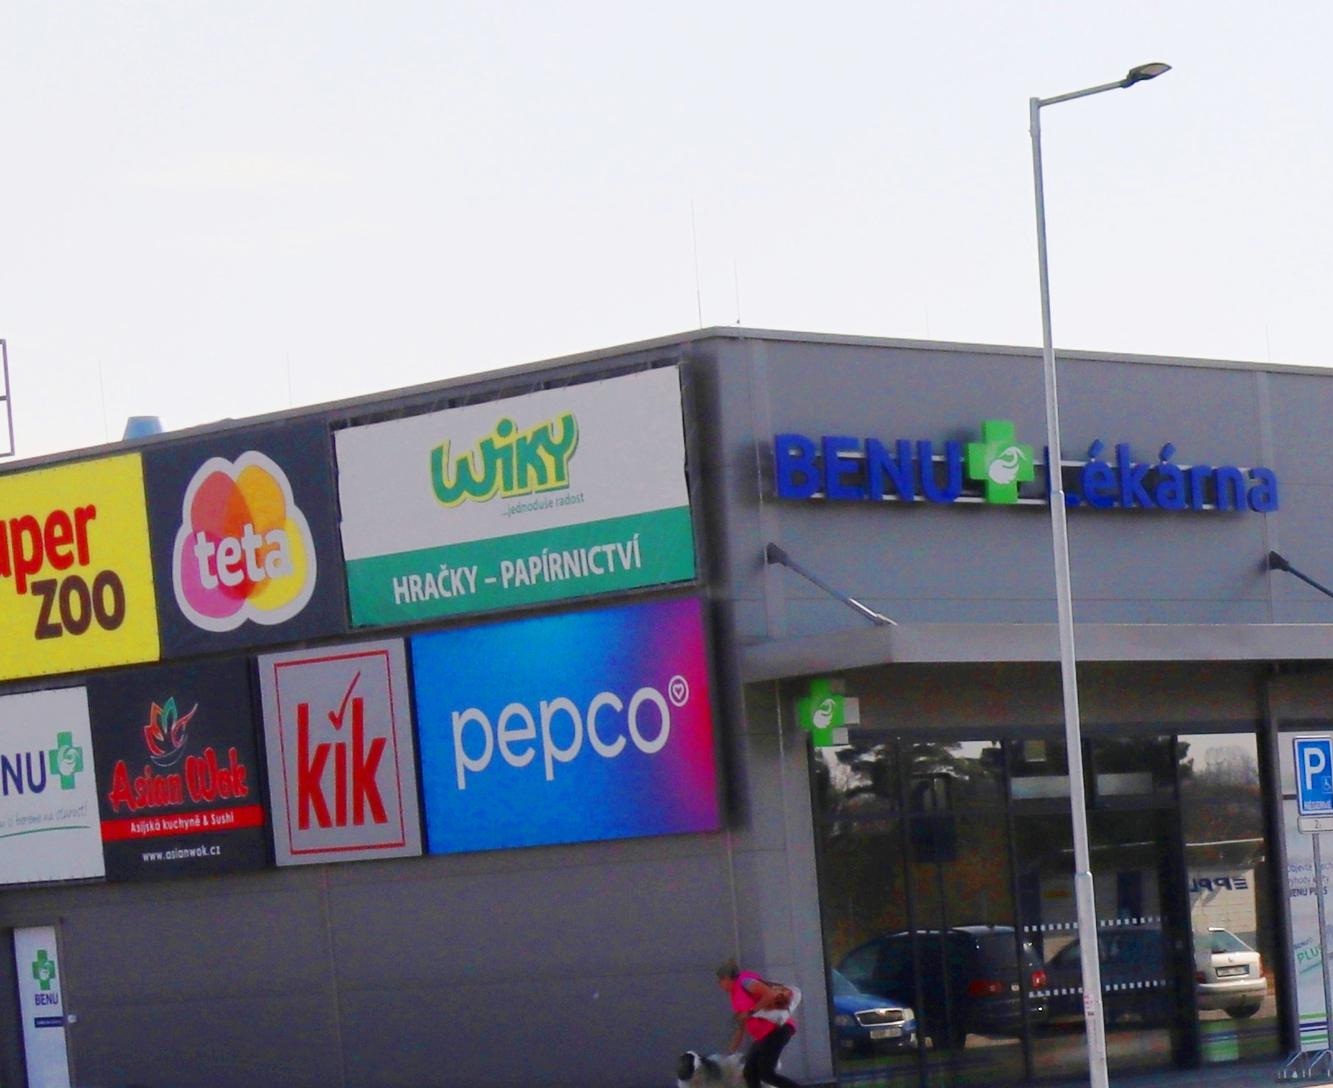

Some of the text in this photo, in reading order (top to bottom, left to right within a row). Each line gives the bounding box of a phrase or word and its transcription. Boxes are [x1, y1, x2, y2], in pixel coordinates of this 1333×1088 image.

[774, 433, 963, 502] BENU
[555, 492, 585, 507] radost
[193, 522, 295, 590] teta
[392, 563, 478, 605] HRAČKY
[501, 532, 642, 589] PAPÍRNICTVÍ
[451, 686, 671, 790] pepco
[108, 747, 249, 814] Asian Wok
[1303, 747, 1326, 791] P
[131, 812, 235, 835] Asijská kuchyně & Sushi
[142, 844, 221, 862] www.asianwok.cz
[1297, 942, 1322, 963] PLU
[34, 992, 59, 1006] BENU
